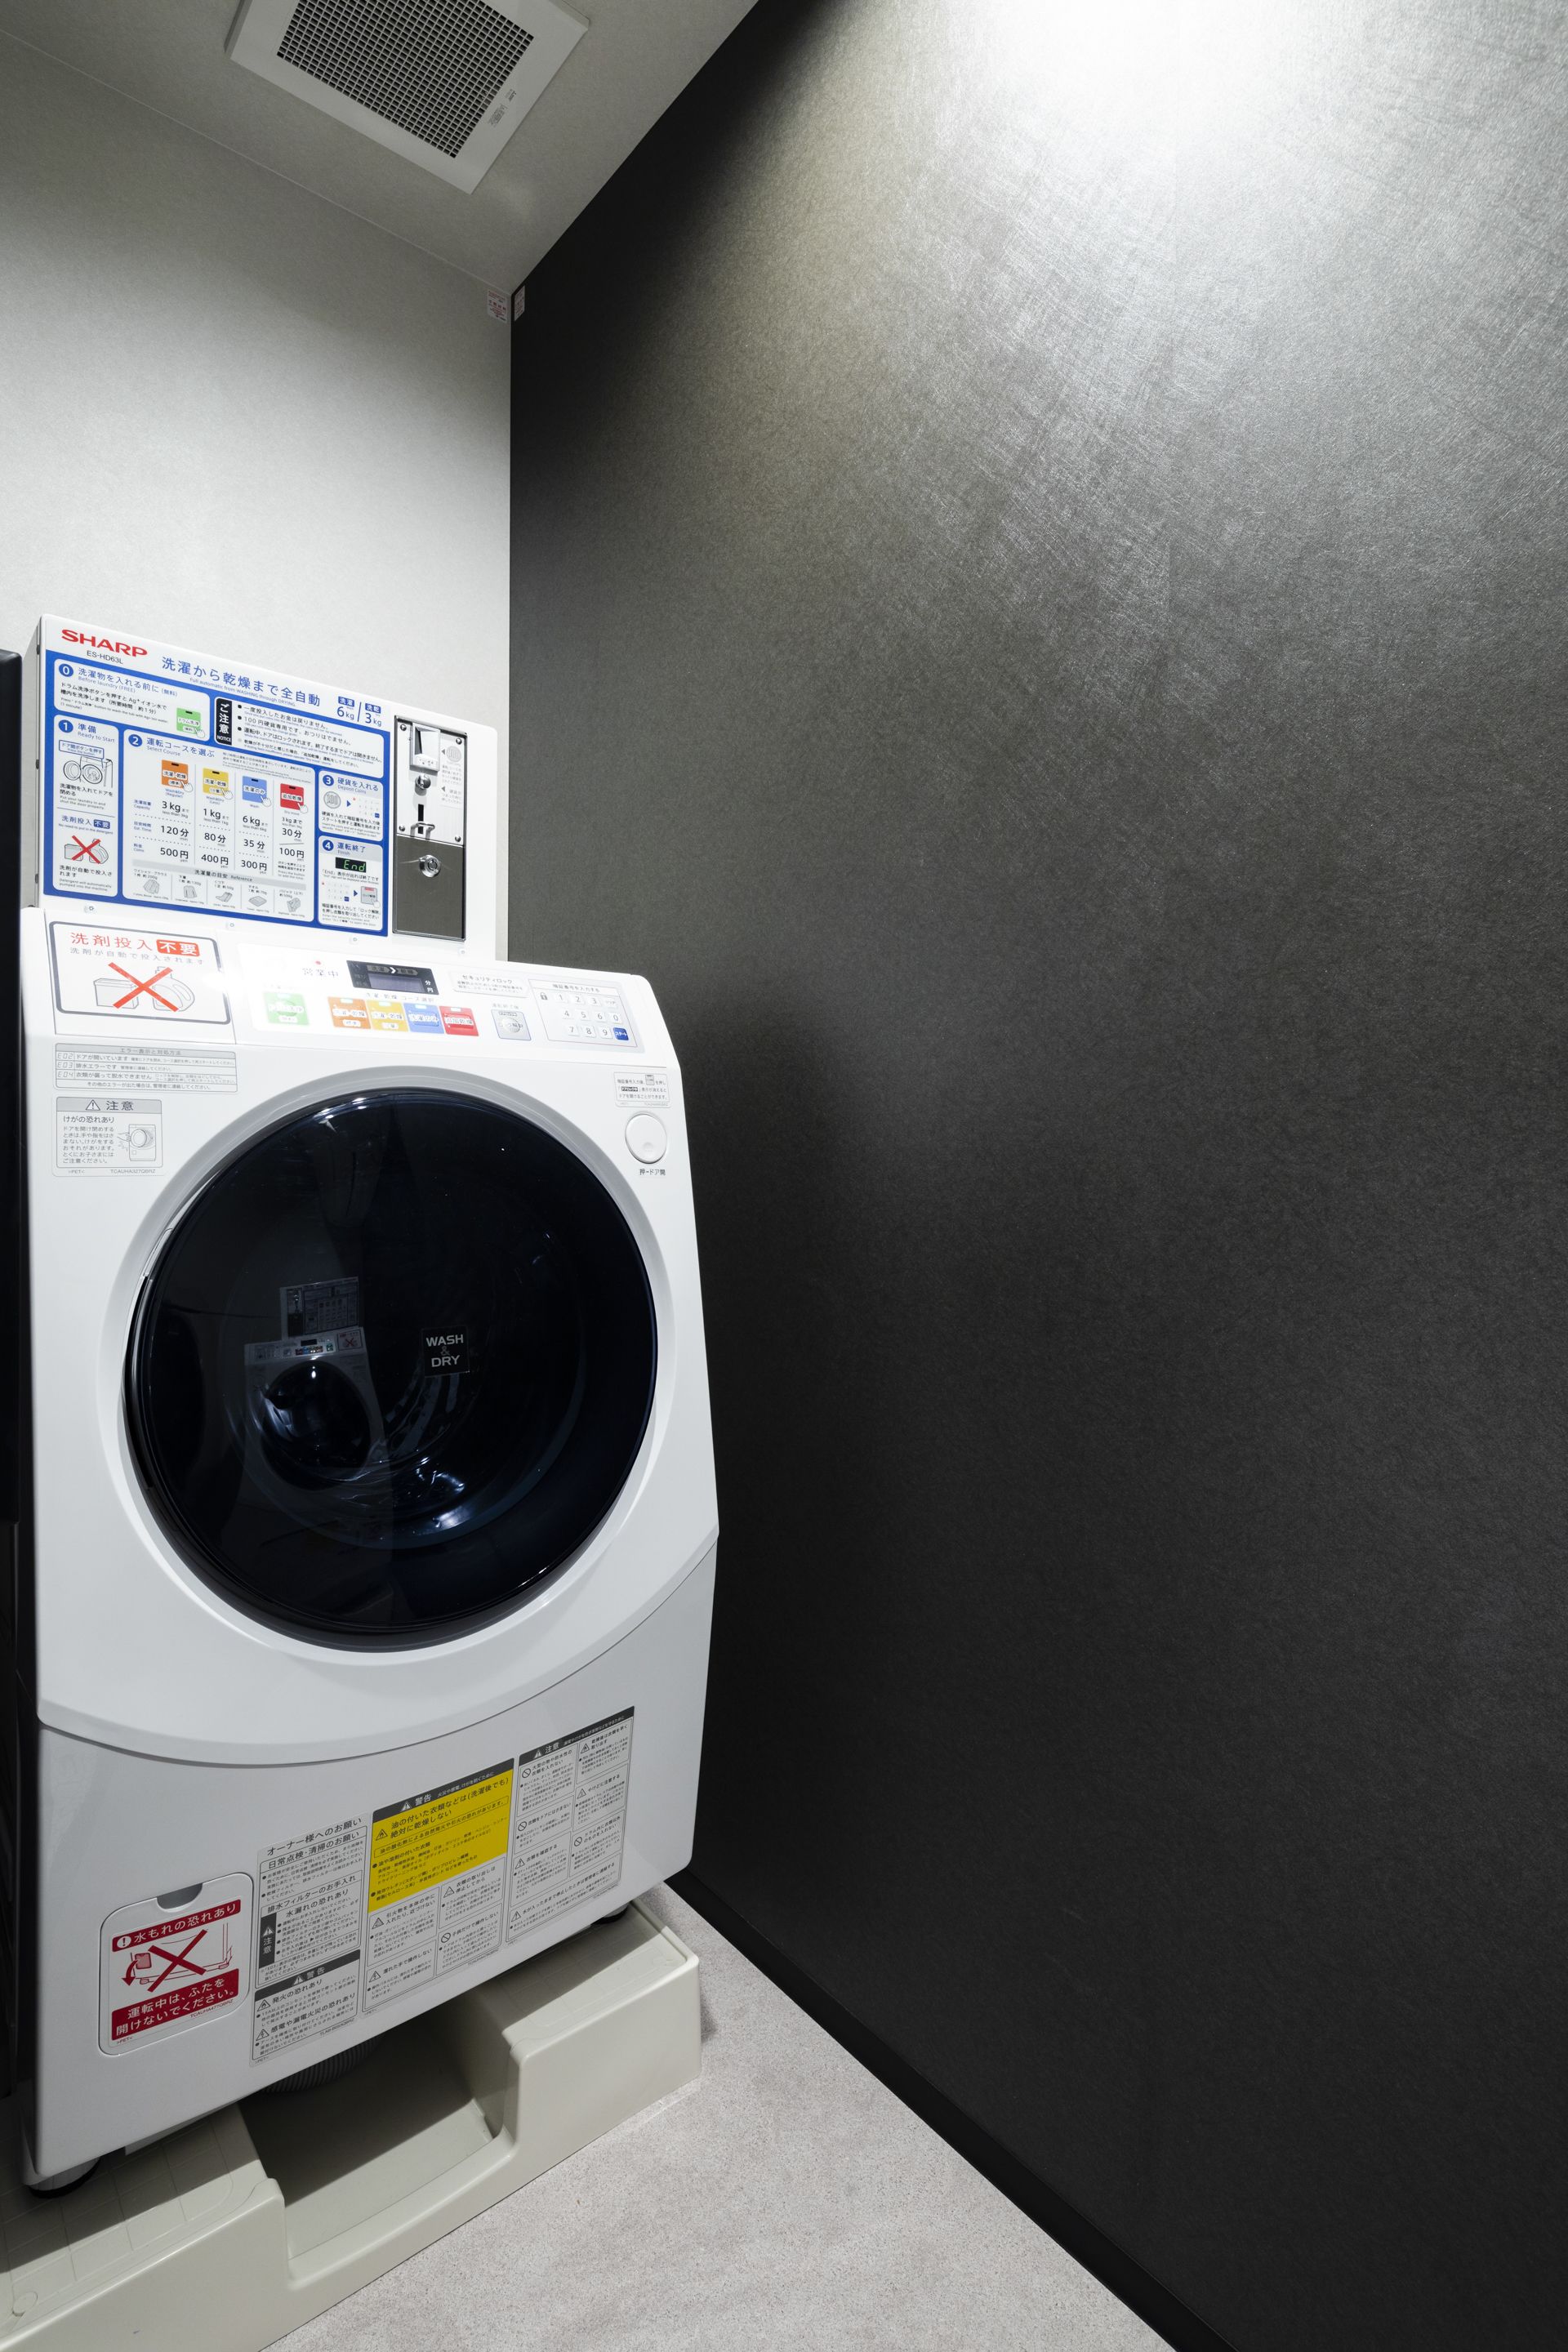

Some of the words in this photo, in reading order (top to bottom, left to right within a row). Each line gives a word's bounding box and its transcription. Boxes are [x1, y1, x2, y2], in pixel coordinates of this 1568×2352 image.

[62, 630, 147, 657] SHARP
[87, 650, 123, 664] ES-HD63L
[63, 666, 70, 675] 0
[78, 676, 96, 684] Before
[98, 679, 118, 690] laundry
[162, 657, 320, 706] 洗濯から乾燥まで全自動
[219, 702, 231, 734] ご注意
[336, 706, 345, 717] 6
[345, 711, 354, 720] kg
[365, 713, 372, 724] 3
[373, 718, 382, 727] kg
[63, 723, 68, 731] 1
[78, 723, 96, 733] 準備
[78, 732, 95, 741] Ready
[102, 735, 115, 743] Start
[132, 737, 139, 746] 2
[147, 738, 215, 757] 運転コースを選ぶ
[163, 748, 180, 756] Course
[60, 783, 114, 796] 洗濯物を入れてドアを
[337, 777, 379, 791] 硬貨を入れる
[169, 802, 180, 813] kg
[210, 809, 220, 820] kg
[250, 816, 261, 826] kg
[61, 816, 91, 826] 洗剤投入
[94, 820, 109, 829] 不要
[325, 841, 331, 849] 4
[337, 842, 366, 853] 運転終了
[160, 848, 189, 860] 500円
[279, 848, 305, 858] 100円
[201, 854, 229, 866] 400円
[241, 860, 267, 871] 300円
[344, 859, 366, 872] End
[60, 866, 112, 877] 洗剤が自動で投入さ
[194, 869, 228, 879] 洗濯量の目安
[71, 933, 153, 951] 洗剤投入
[159, 941, 197, 956] 不要
[70, 947, 203, 965] 洗剤が自動で投入されます
[77, 1054, 128, 1062] ドアが開いています
[121, 1048, 181, 1056] エラー表示と対処方法
[105, 1100, 134, 1111] 注意
[63, 1116, 114, 1124] けがの恐れあり
[425, 1334, 464, 1347] WASH
[431, 1354, 461, 1368] DRY
[545, 1742, 559, 1754] 注意
[415, 1793, 432, 1806] 警告
[390, 1809, 452, 1839] 絶対に乾燥しない
[267, 1818, 362, 1856] オーナー様へのお願い
[269, 1831, 359, 1869] 日常点検・清掃のお願い
[456, 1878, 485, 1894] 停止してから
[267, 1875, 356, 1913] 排水フィルターのお手入れ
[286, 1888, 349, 1918] 水漏れの恐れあり
[134, 1904, 236, 1943] 水もれの恐れあり
[263, 1937, 273, 1955] 注意
[383, 1948, 433, 1975] 濡れた手で操作しない
[273, 1979, 323, 2003] 発火の恐れあり
[127, 1978, 225, 2020] 運転中は、ふたを
[116, 1989, 234, 2036] 開けないでください。
[271, 1992, 355, 2034] 感電や漏電火災の恐れあり
